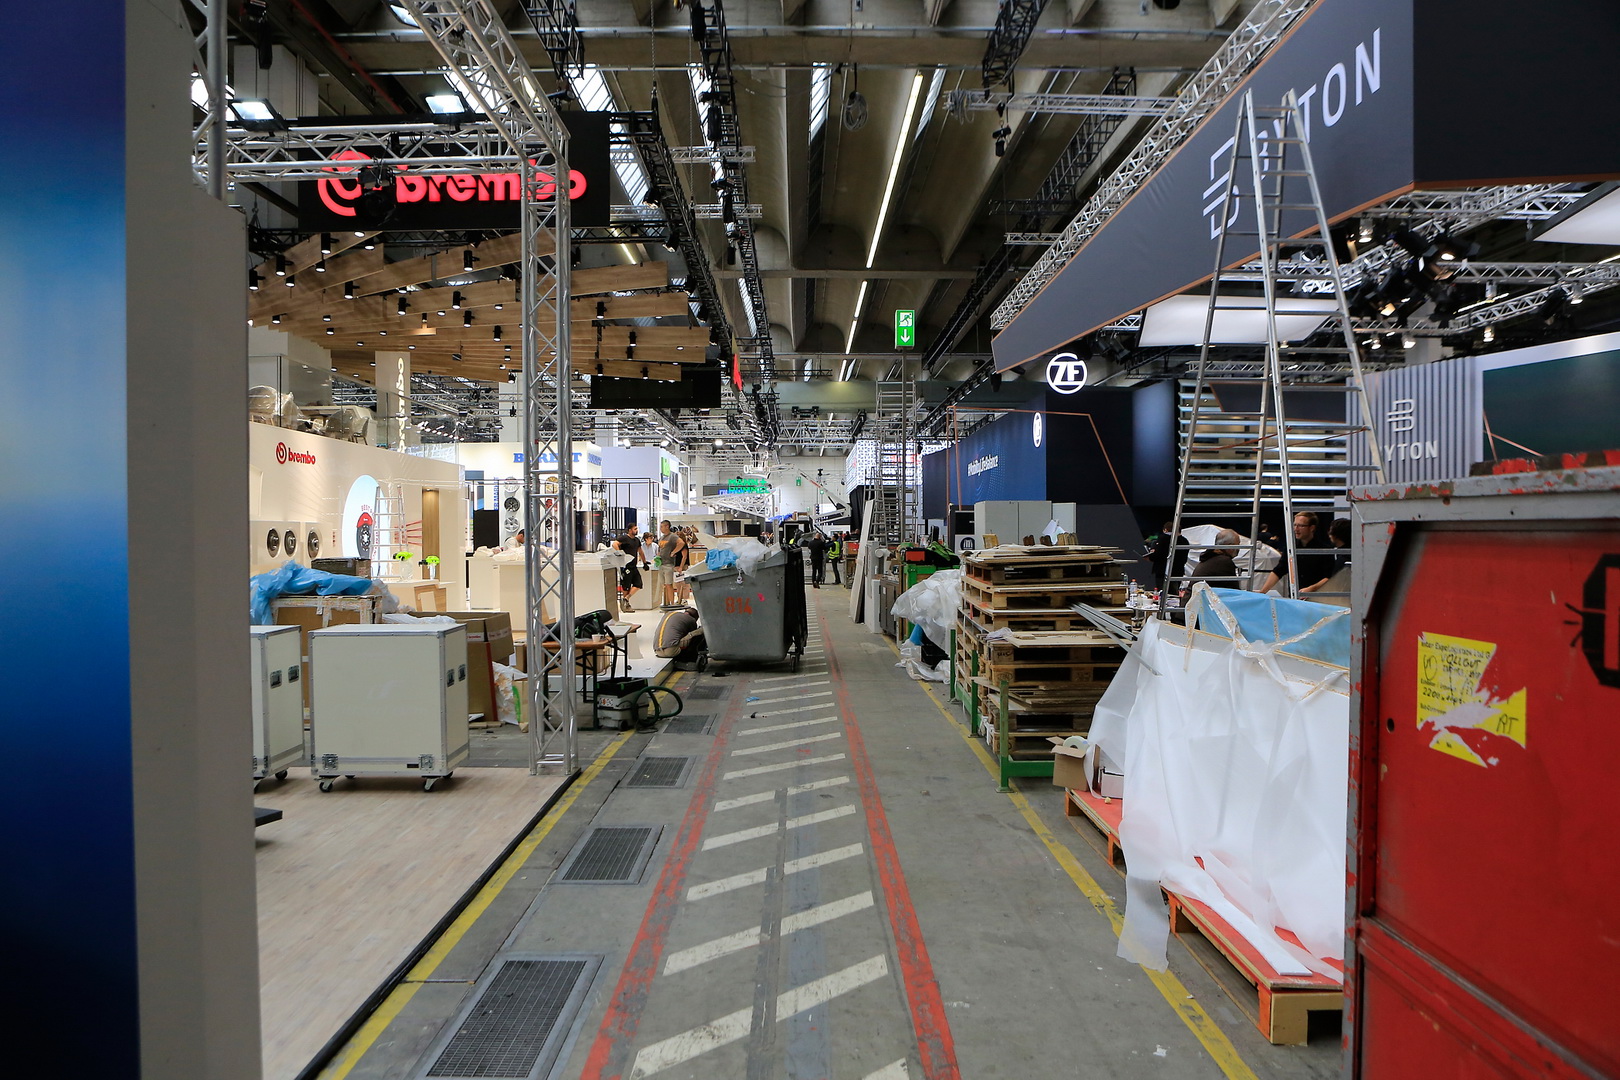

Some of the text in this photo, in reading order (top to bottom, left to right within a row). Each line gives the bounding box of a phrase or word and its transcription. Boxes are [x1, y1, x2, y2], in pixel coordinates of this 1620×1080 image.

[396, 159, 588, 203] brembo
[1047, 359, 1085, 387] ZF
[288, 447, 316, 465] brembo
[1380, 440, 1438, 462] YTON
[724, 595, 753, 615] 814
